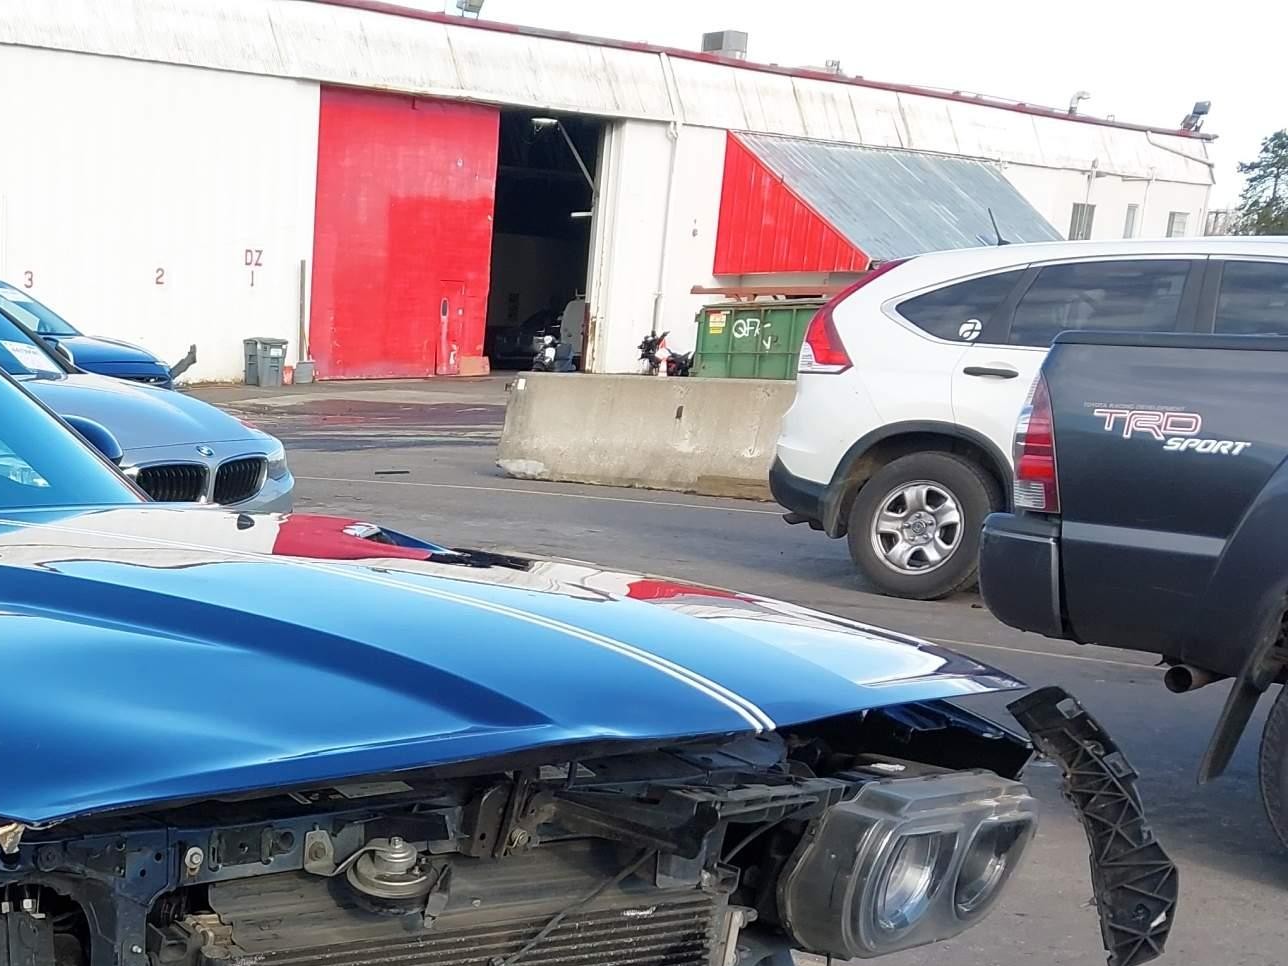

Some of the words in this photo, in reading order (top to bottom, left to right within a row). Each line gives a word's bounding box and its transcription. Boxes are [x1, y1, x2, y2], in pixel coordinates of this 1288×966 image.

[24, 270, 34, 288] 3
[155, 267, 165, 285] 2
[1093, 409, 1202, 440] TRD
[1163, 437, 1251, 456] SPORT
